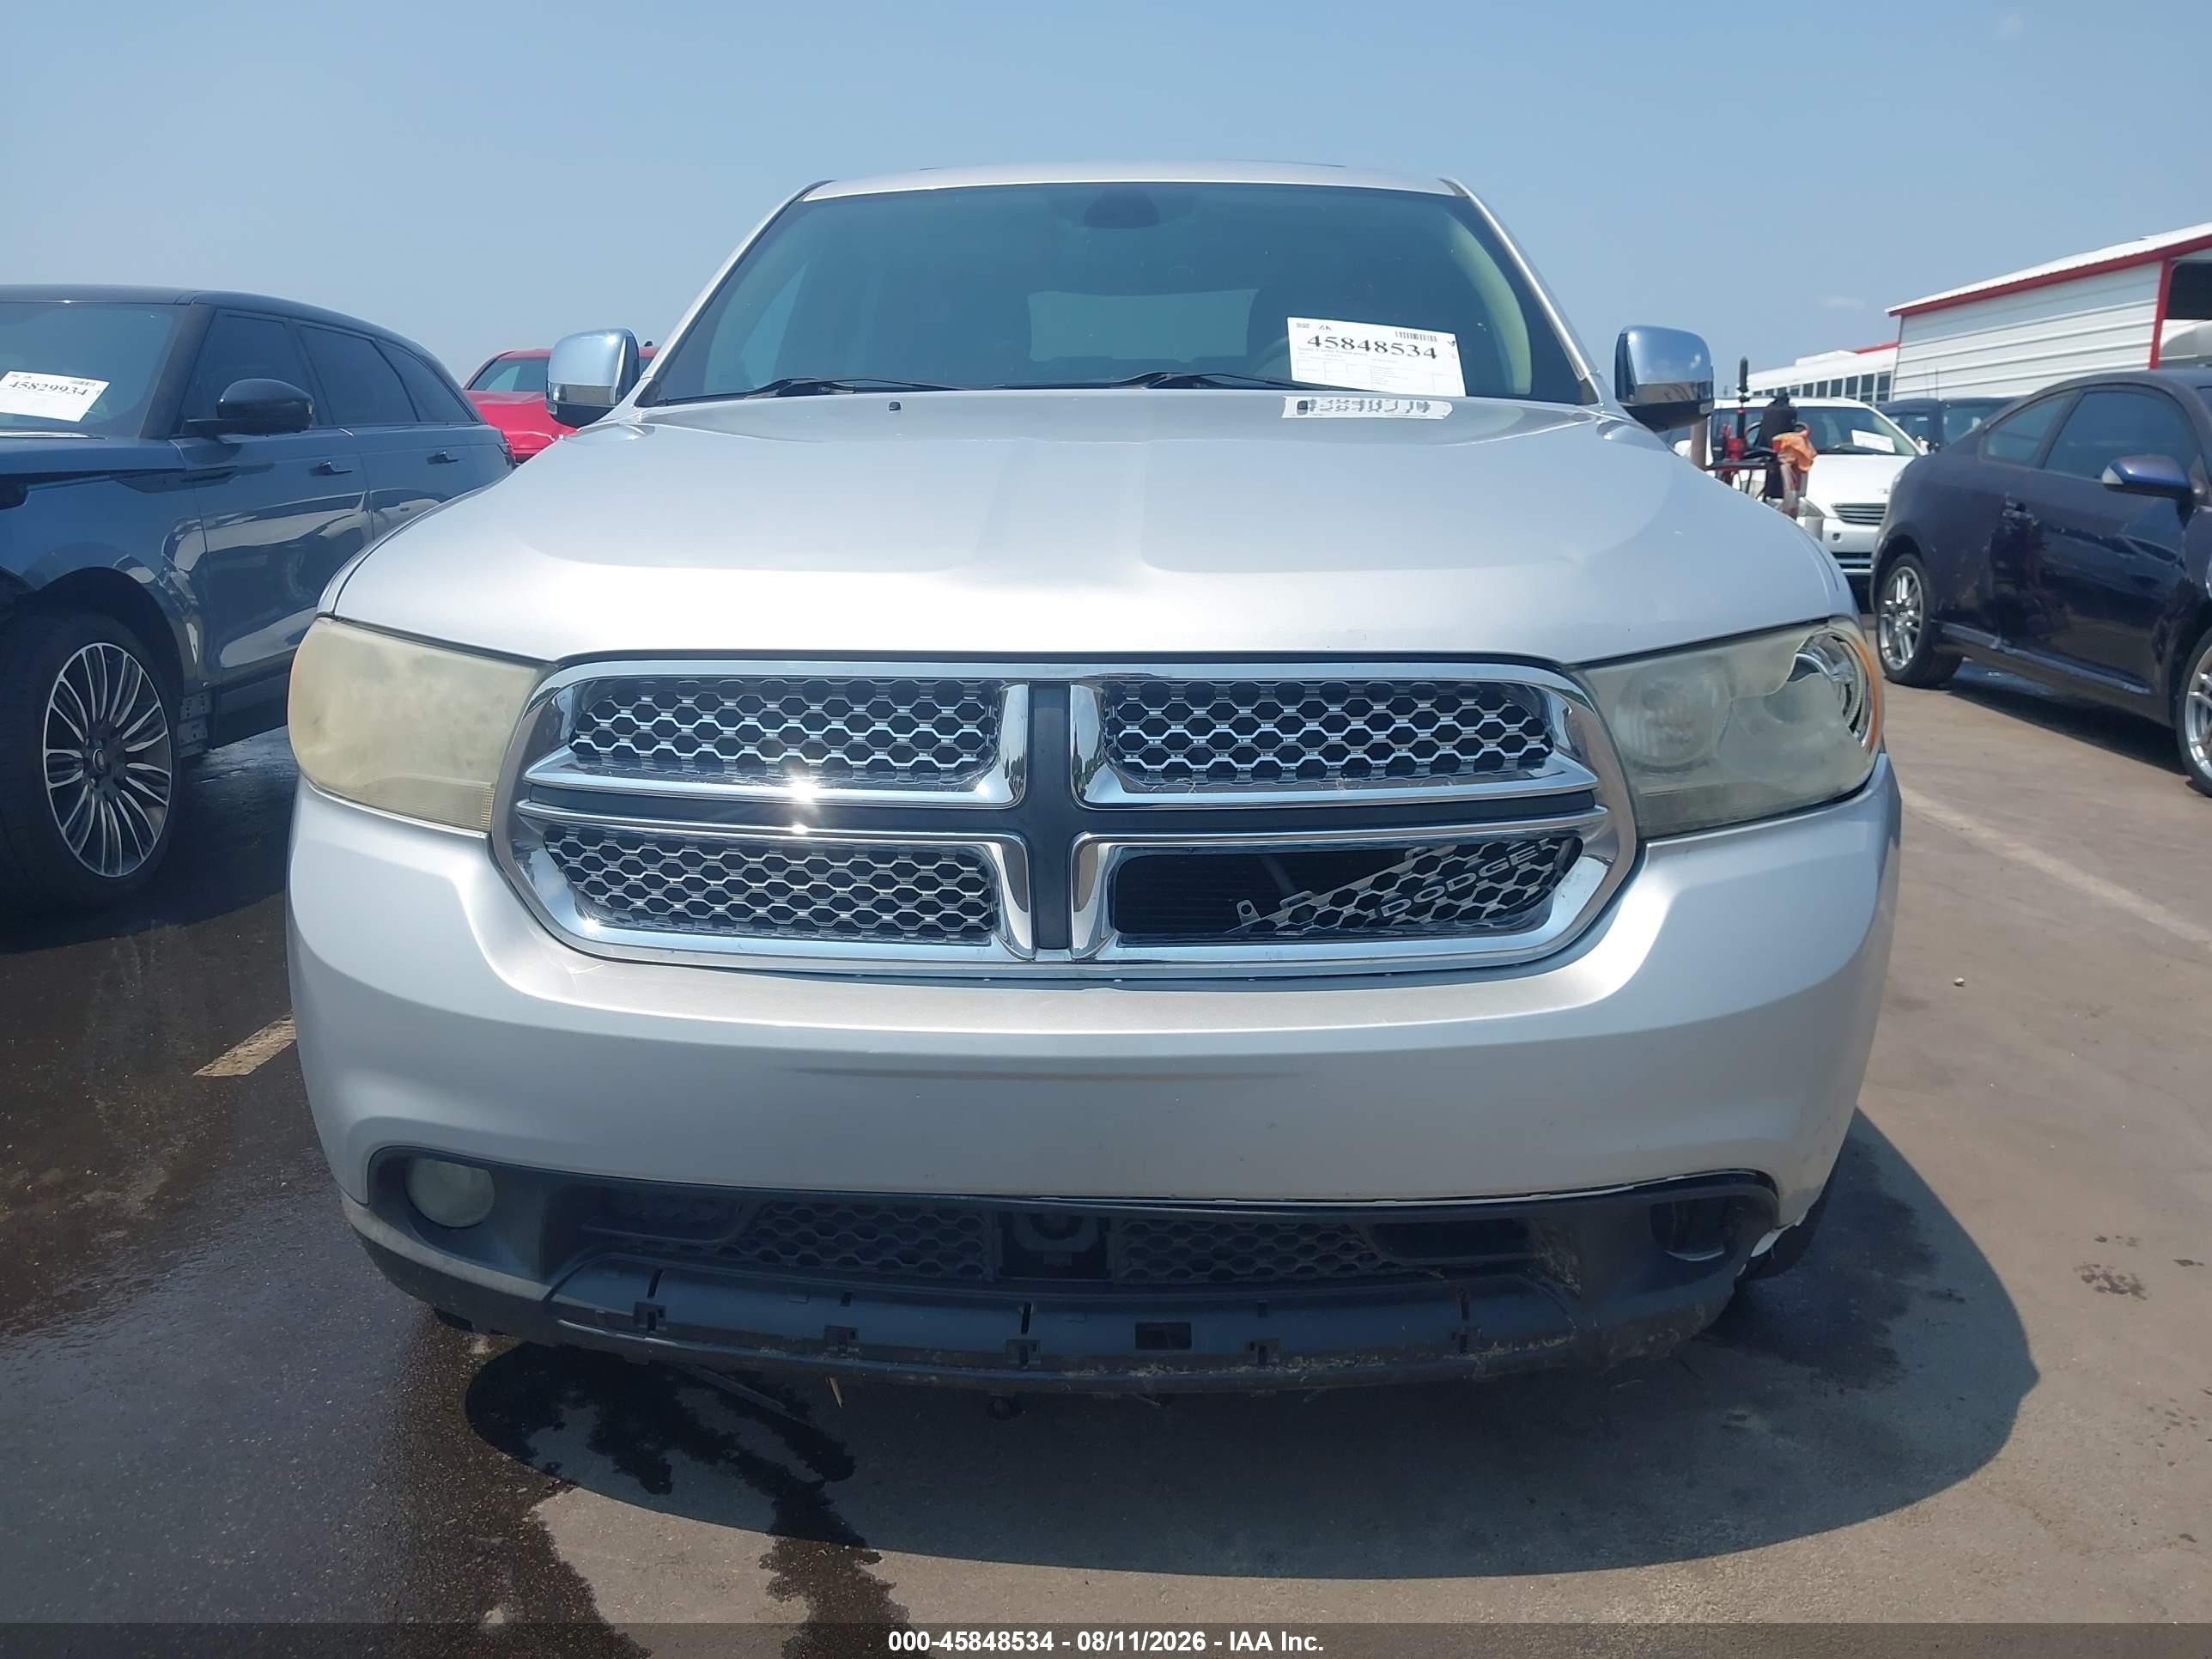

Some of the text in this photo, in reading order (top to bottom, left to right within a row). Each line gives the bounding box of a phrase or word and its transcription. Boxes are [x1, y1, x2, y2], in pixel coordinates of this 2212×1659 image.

[1307, 335, 1437, 359] 45848534
[9, 380, 88, 396] 45829934
[1380, 845, 1539, 917] DODGE
